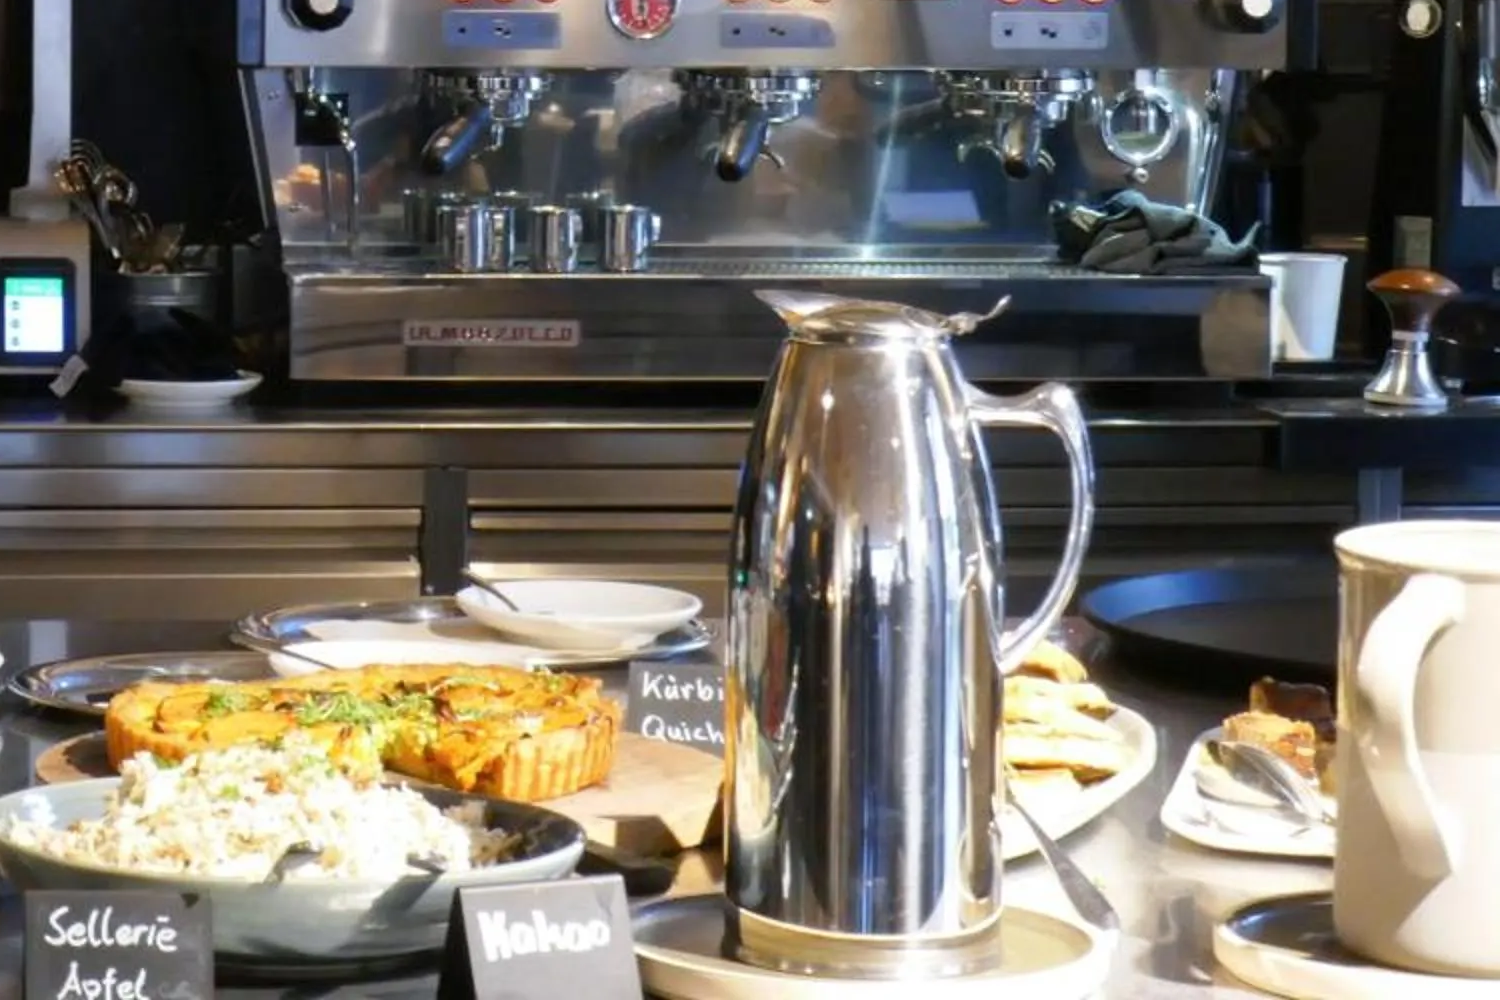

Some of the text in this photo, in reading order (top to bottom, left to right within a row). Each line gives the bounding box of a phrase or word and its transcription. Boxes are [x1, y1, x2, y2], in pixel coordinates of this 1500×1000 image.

[642, 671, 724, 702] Kürbi
[642, 714, 725, 744] Quich
[44, 905, 178, 953] Sellerie
[476, 909, 612, 963] Kakao
[56, 960, 151, 1000] Apfel
